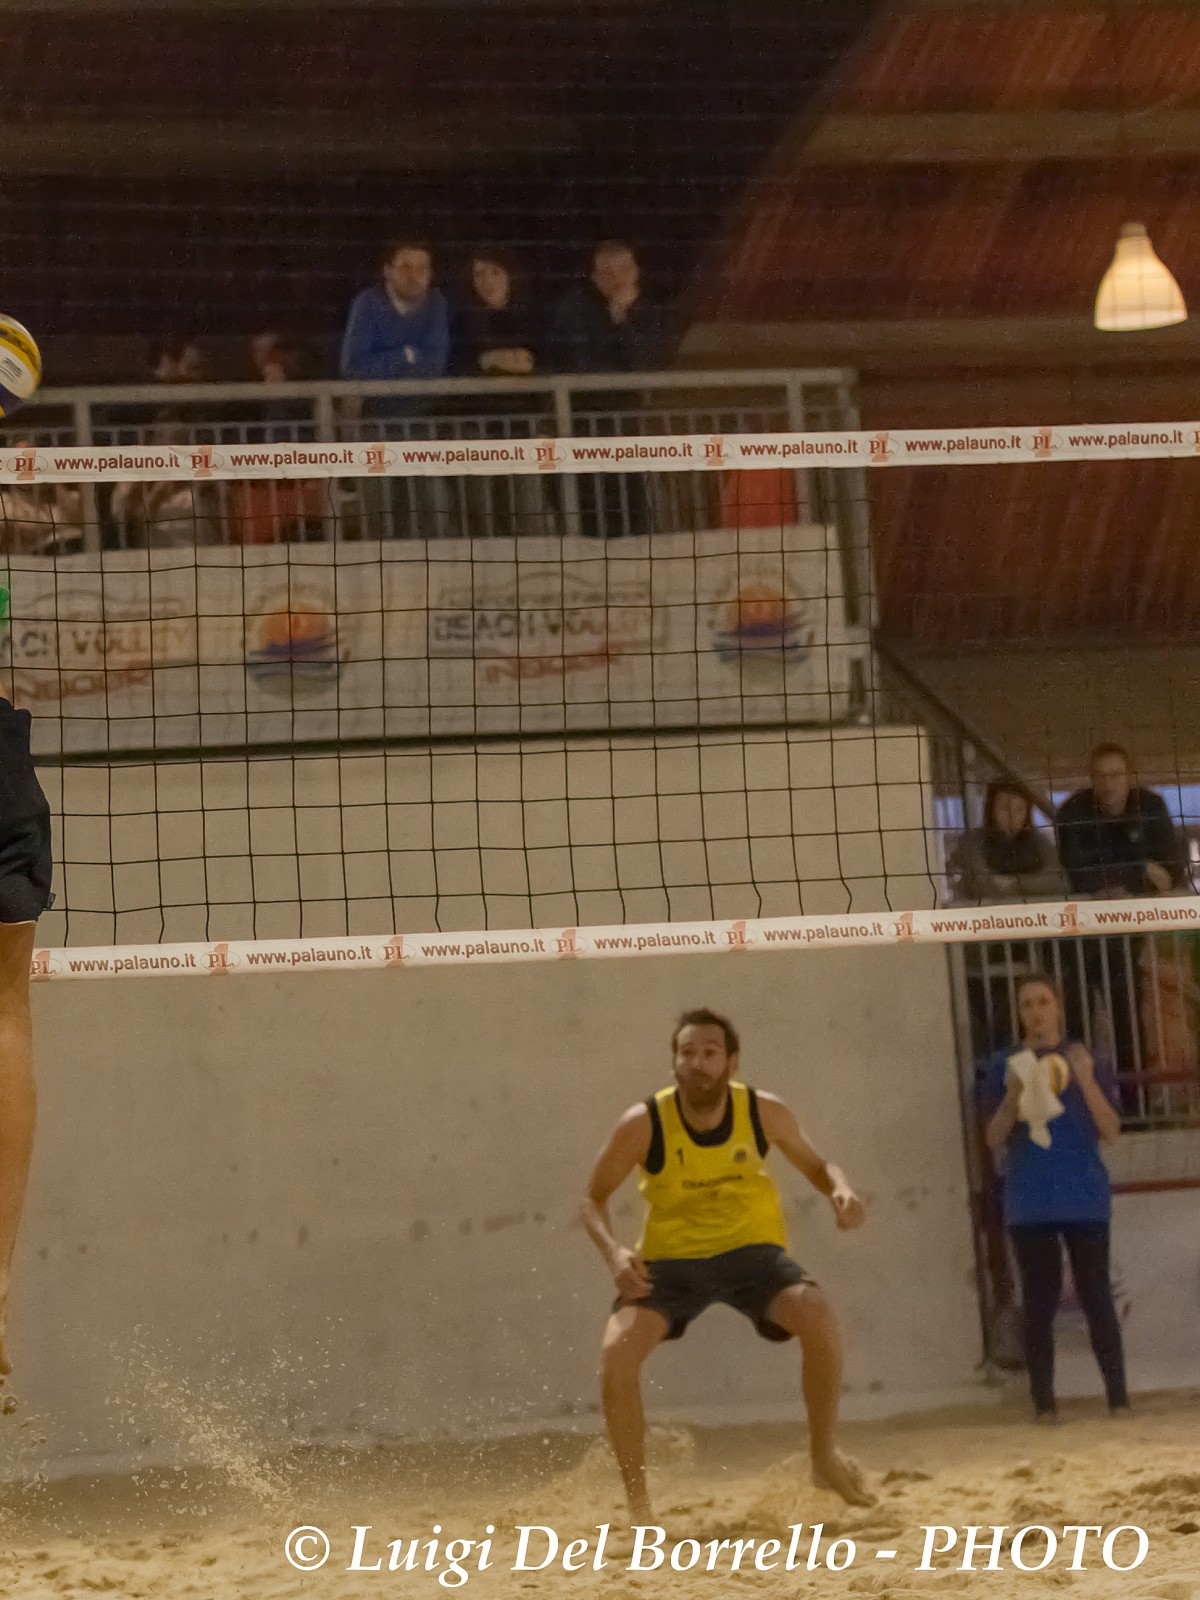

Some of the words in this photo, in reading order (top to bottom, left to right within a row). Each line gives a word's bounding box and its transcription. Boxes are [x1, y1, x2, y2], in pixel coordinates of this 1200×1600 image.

[54, 454, 180, 473] www.palauno.it
[230, 449, 353, 468] www.palauno.it
[403, 446, 525, 465] www.palauno.it
[572, 443, 693, 462] www.palauno.it
[740, 439, 858, 458] www.palauno.it
[905, 435, 1021, 453] www.palauno.it
[1069, 430, 1182, 448] www.palauno.it
[69, 954, 196, 974] www.palauno.it
[247, 945, 372, 965] www.palauno.it
[421, 938, 545, 959] www.palauno.it
[594, 931, 716, 951] www.palauno.it
[763, 923, 883, 942] www.palauno.it
[931, 913, 1047, 933] www.palauno.it
[1095, 907, 1200, 924] www.palauno.
